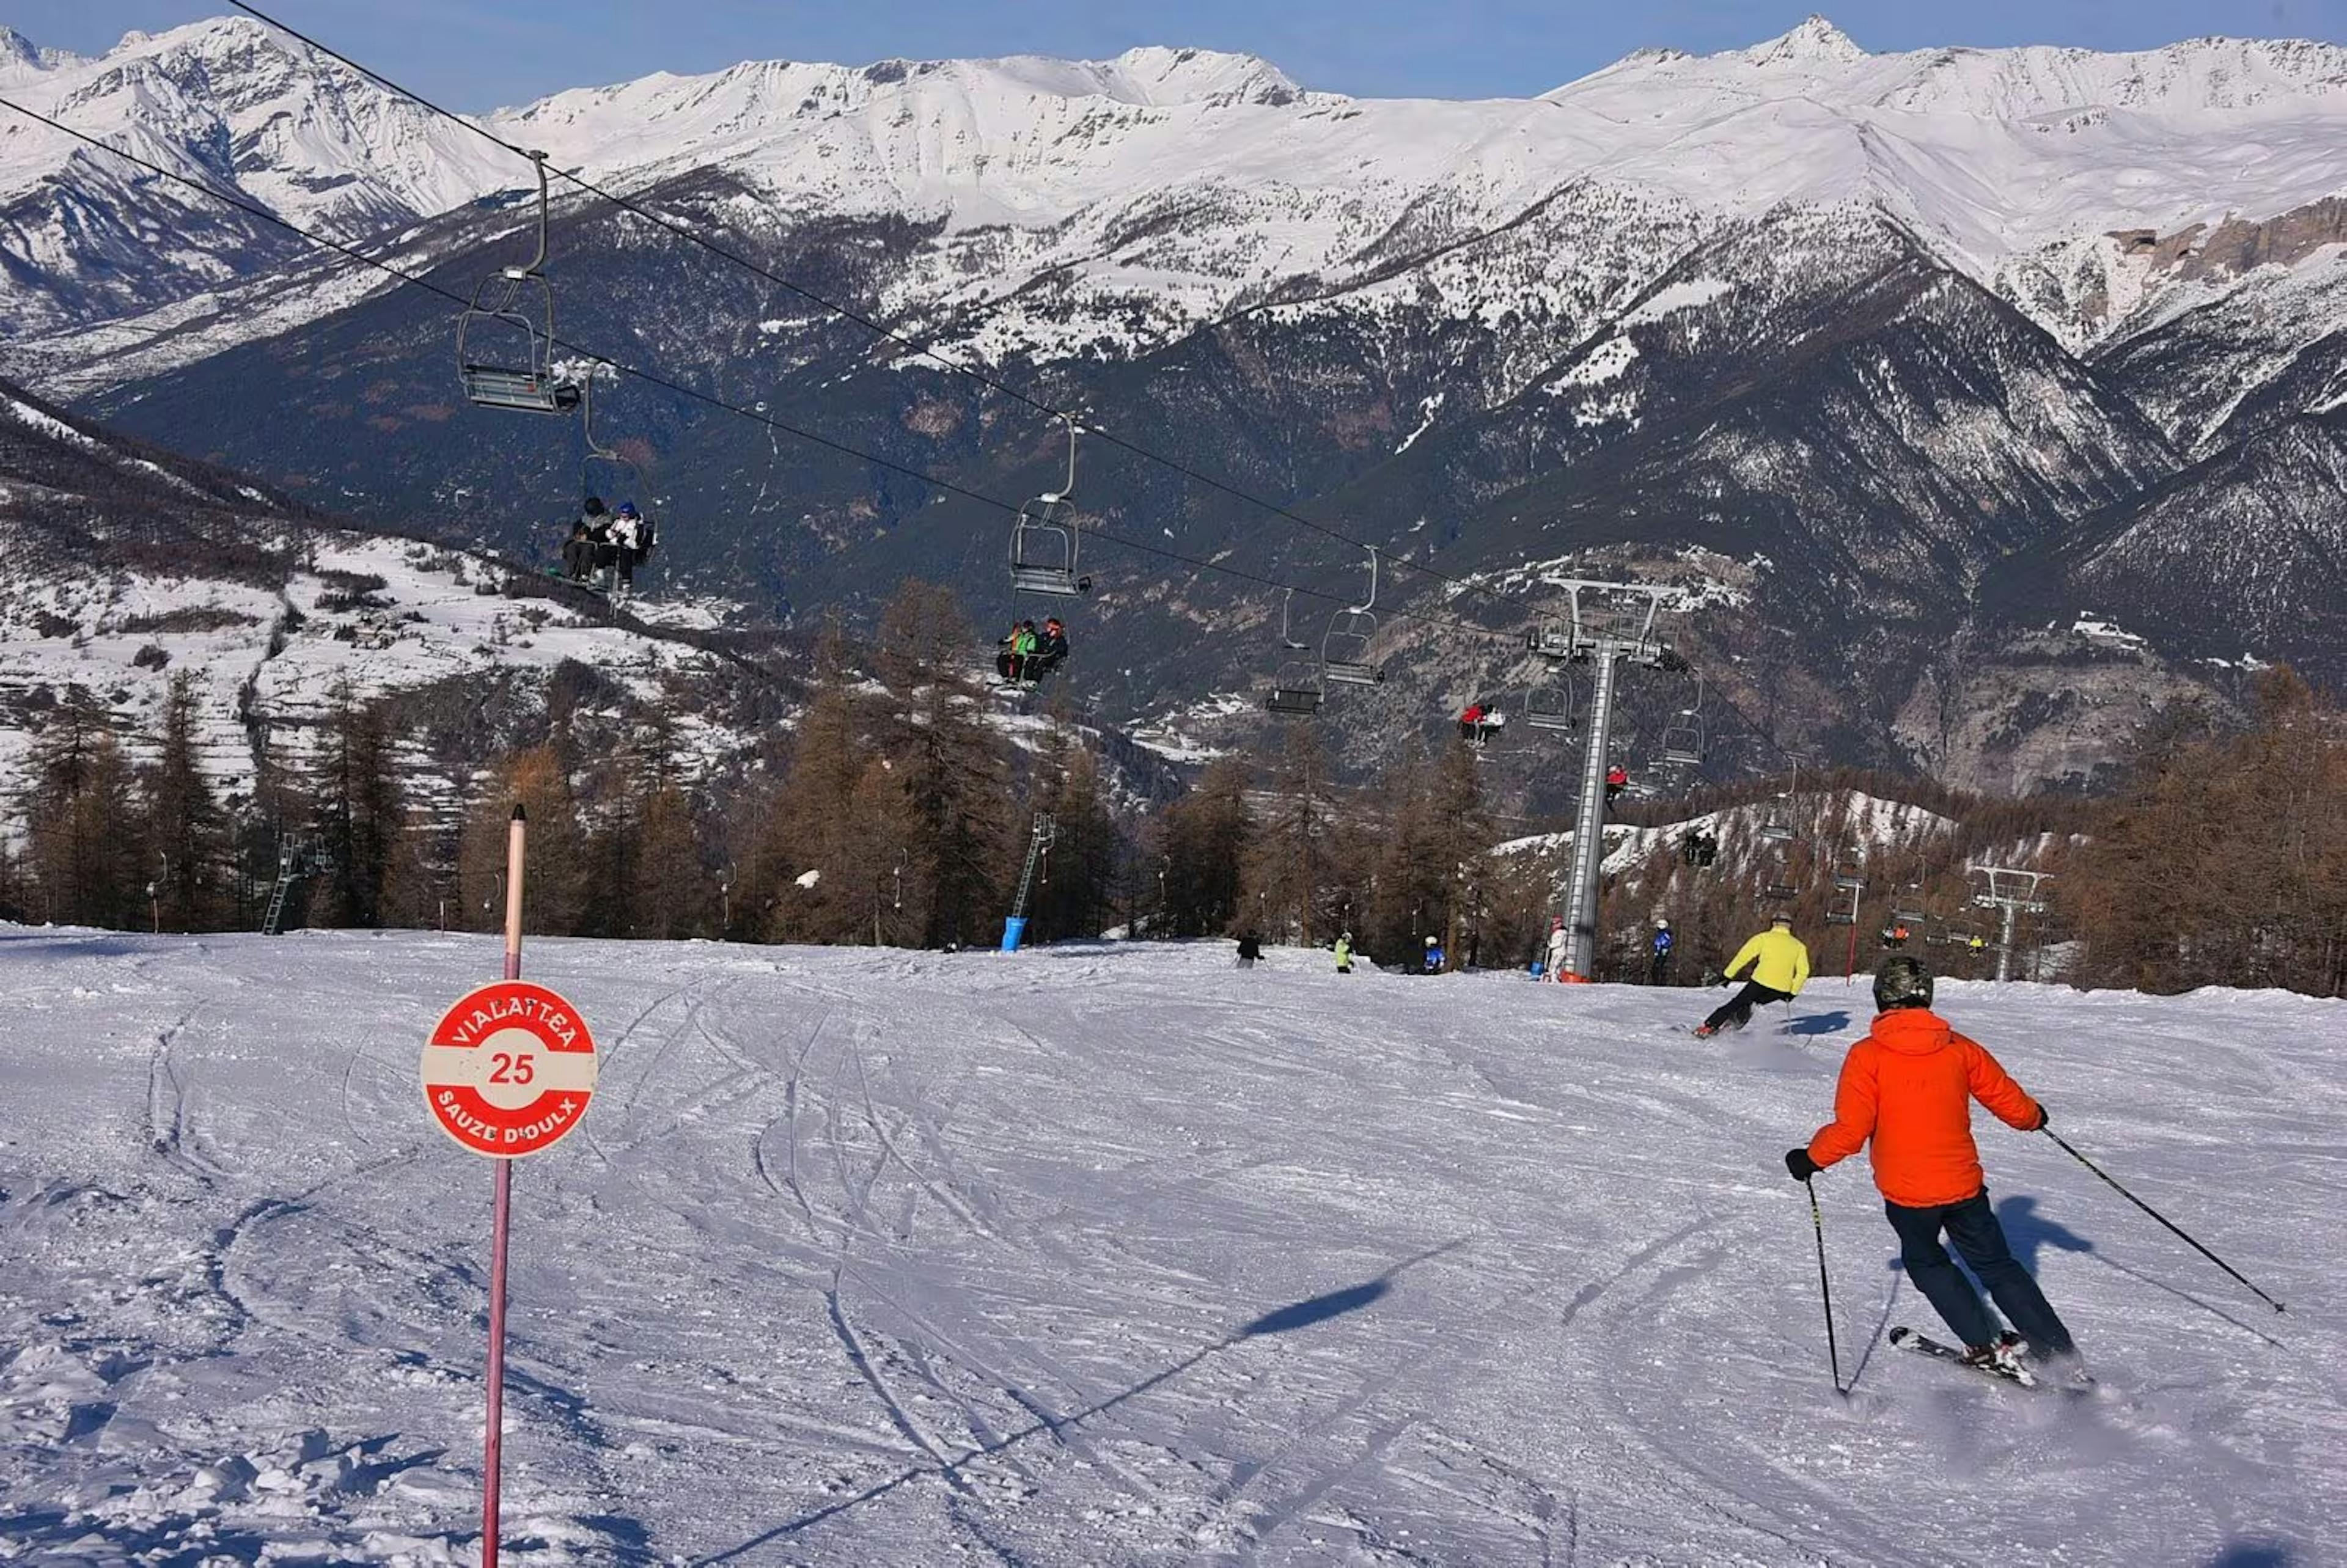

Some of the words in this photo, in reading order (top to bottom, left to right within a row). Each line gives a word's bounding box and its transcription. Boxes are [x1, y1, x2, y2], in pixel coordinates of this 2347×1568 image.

[489, 1053, 534, 1085] 25
[438, 1090, 497, 1142] SAUZE
[504, 1097, 577, 1143] D'OULX
